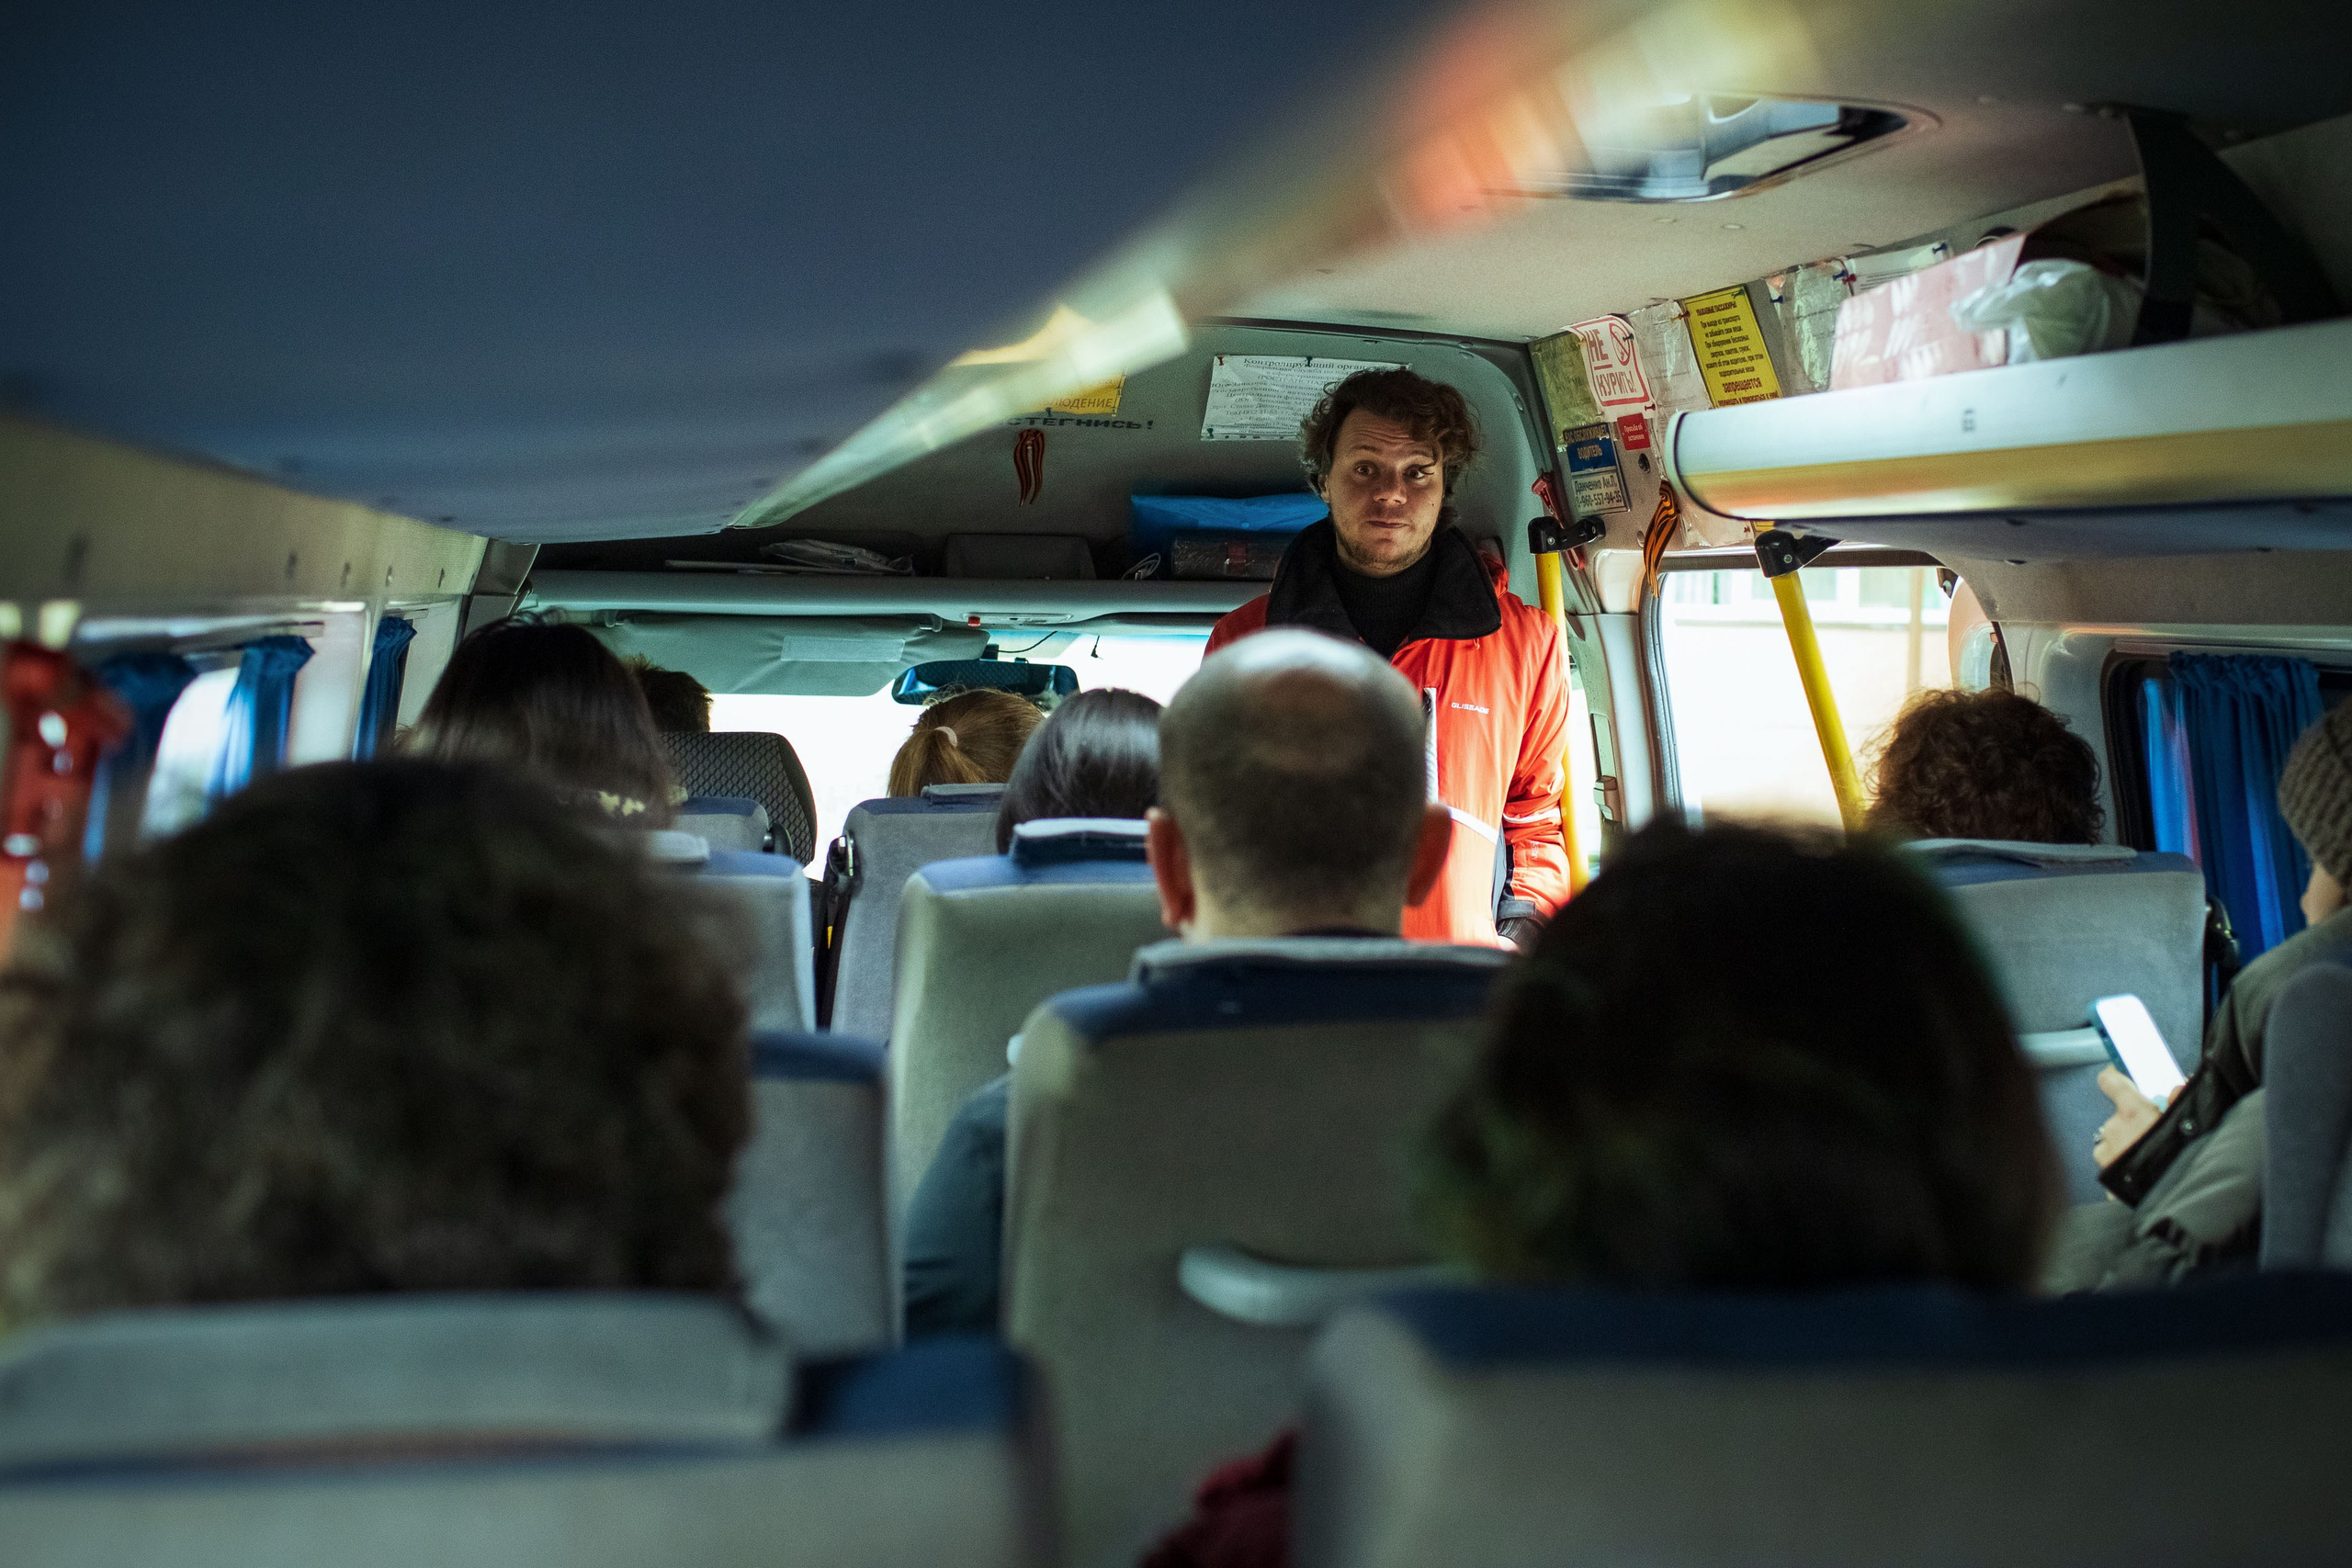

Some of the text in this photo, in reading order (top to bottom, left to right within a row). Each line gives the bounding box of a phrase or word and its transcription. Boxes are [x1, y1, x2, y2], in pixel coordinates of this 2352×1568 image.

[1588, 328, 1610, 362] НЕ
[1596, 370, 1637, 397] КУРИТЬ!
[1722, 377, 1763, 395] запрещается
[1044, 398, 1114, 410] ЛЮДЕНИЕ
[1007, 417, 1154, 429] СТЕГНИСЬ!
[1577, 444, 1603, 460] ВОДИТЕЛЬ
[1451, 702, 1489, 714] GLISSADE
